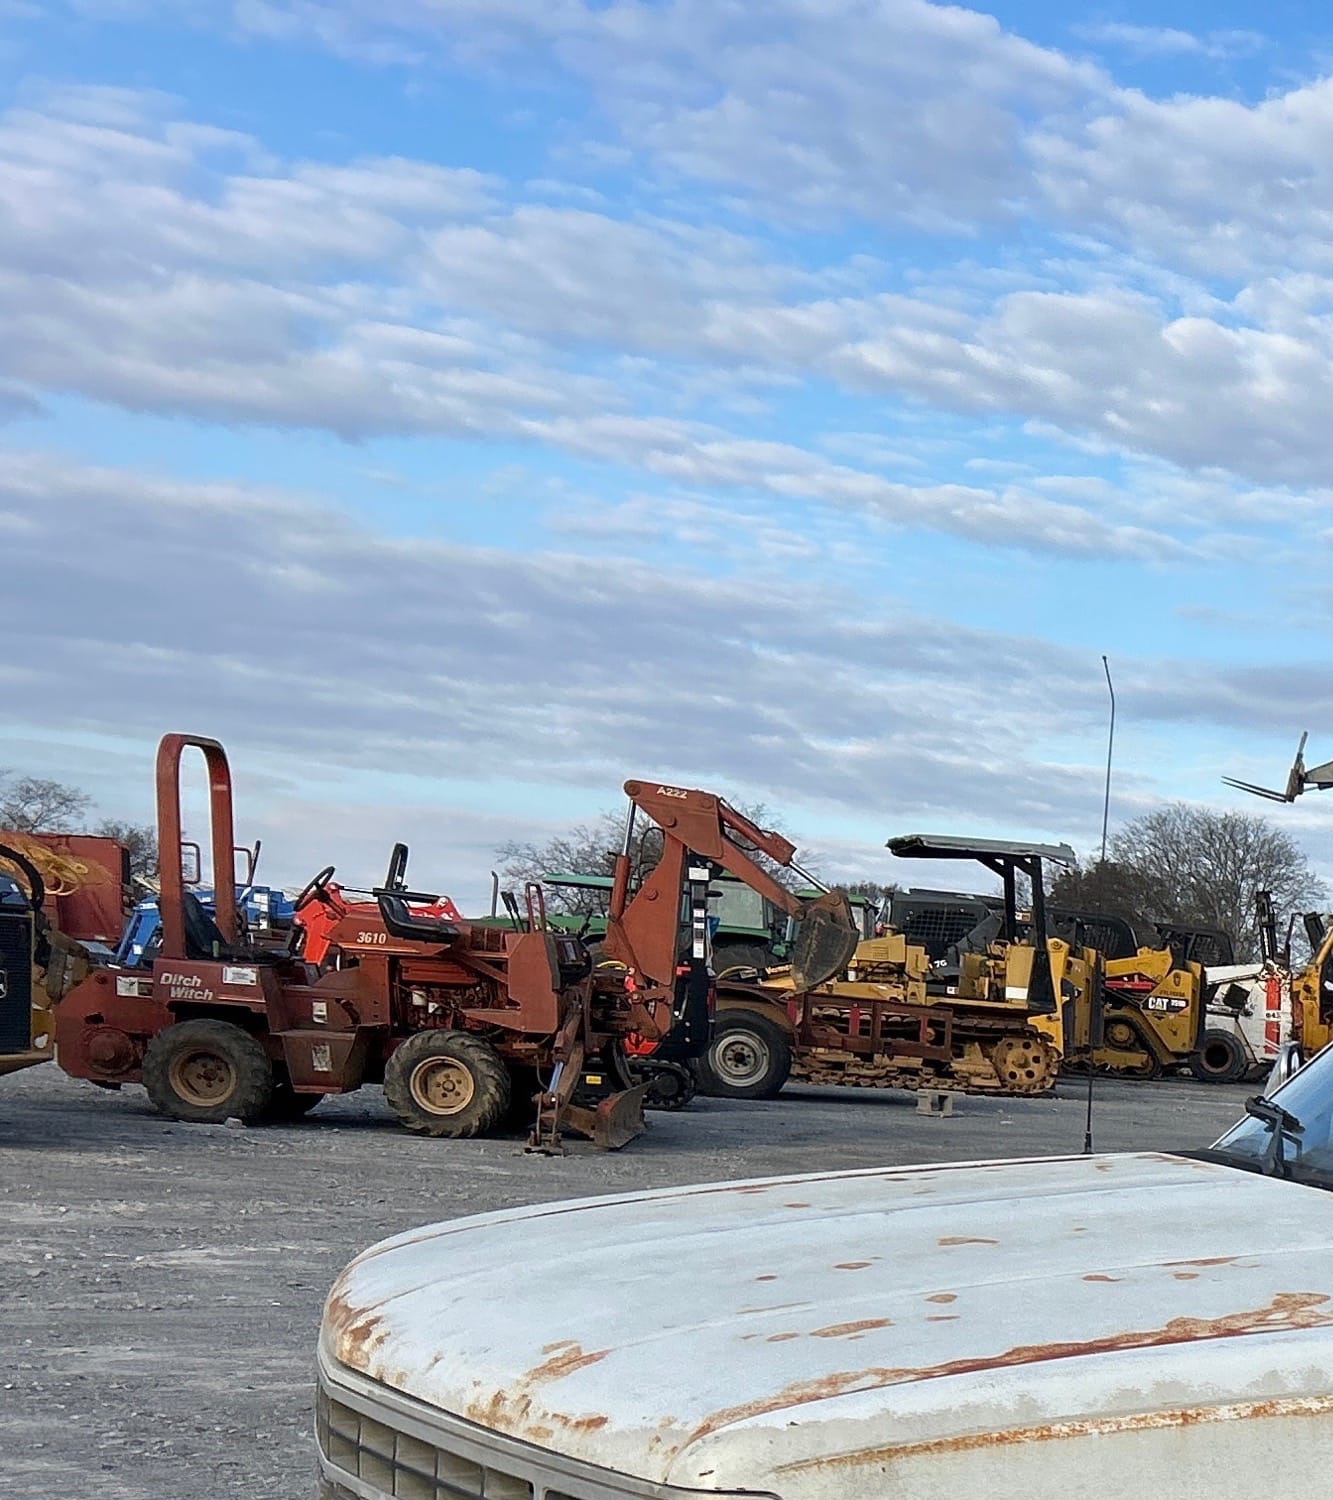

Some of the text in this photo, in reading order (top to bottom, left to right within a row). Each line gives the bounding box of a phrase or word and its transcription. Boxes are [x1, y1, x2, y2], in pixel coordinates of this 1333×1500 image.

[656, 786, 688, 799] A222
[356, 931, 387, 944] 3610
[160, 973, 202, 987] Ditch
[170, 987, 213, 1000] Witch
[1148, 997, 1169, 1010] CAT
